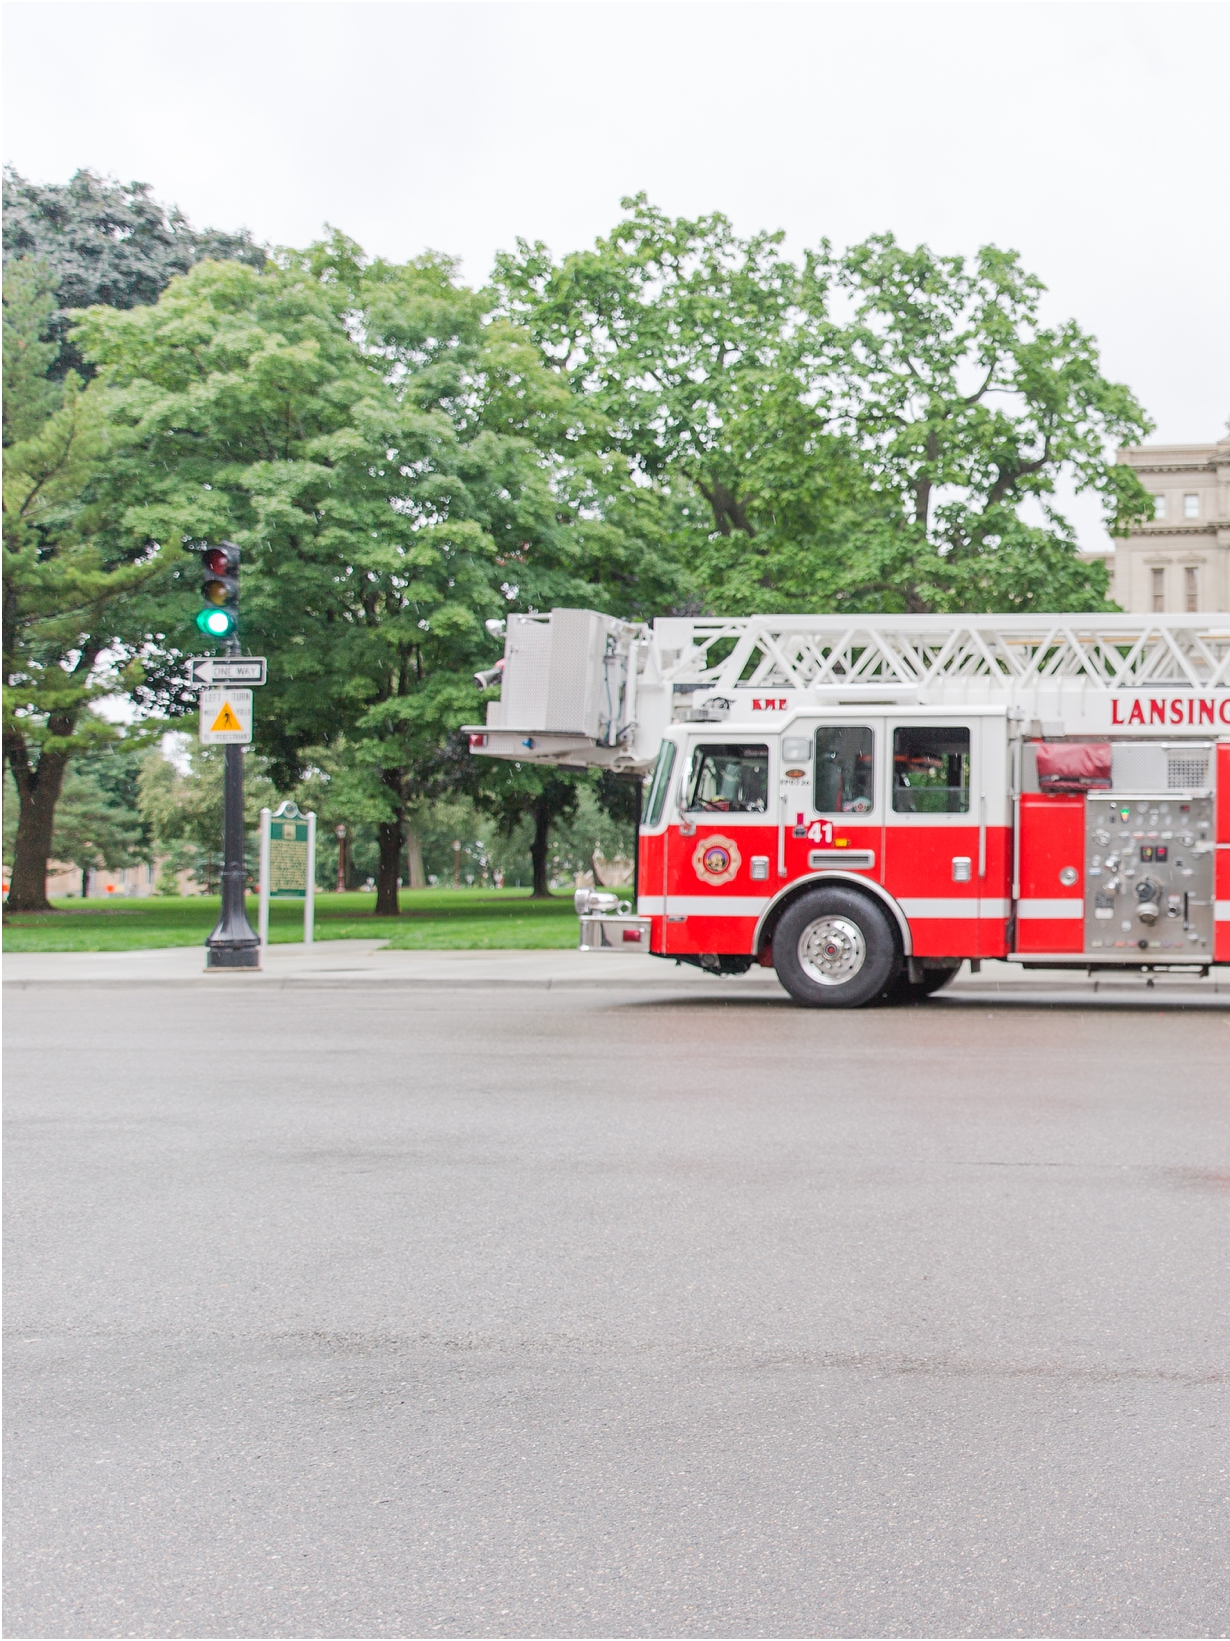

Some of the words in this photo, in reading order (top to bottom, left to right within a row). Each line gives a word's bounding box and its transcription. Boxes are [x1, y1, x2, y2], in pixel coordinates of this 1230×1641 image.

[214, 666, 233, 677] ONE
[237, 666, 257, 677] WAY
[232, 692, 250, 702] TURN
[807, 821, 833, 843] 41
